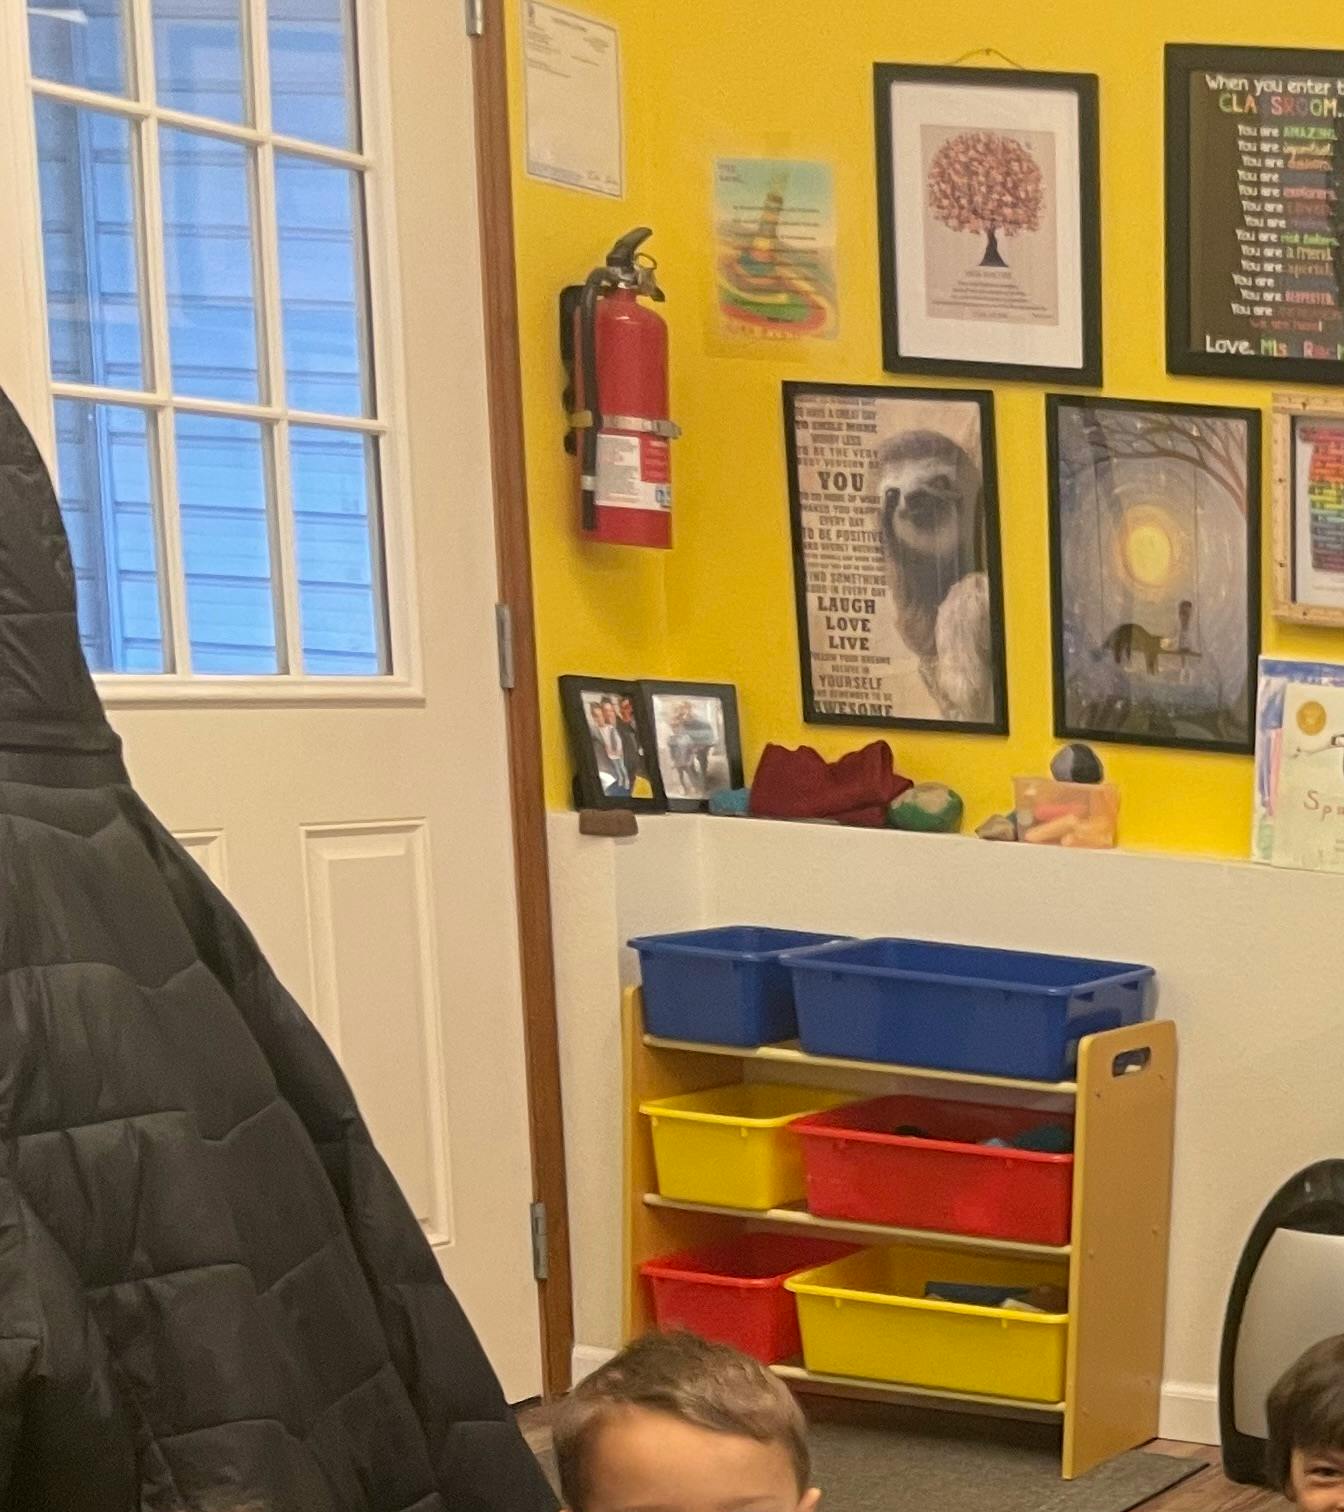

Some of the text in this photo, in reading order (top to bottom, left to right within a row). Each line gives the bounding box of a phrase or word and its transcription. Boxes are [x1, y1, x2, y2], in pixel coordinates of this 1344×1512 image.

[1205, 74, 1249, 92] When
[1254, 80, 1282, 96] you
[1287, 79, 1331, 95] enter
[1237, 125, 1257, 136] You
[1260, 126, 1279, 137] are
[1237, 140, 1257, 151] You
[1260, 142, 1280, 152] are
[1241, 155, 1261, 167] You
[1265, 157, 1284, 168] are
[1237, 170, 1279, 182] You are
[1238, 184, 1280, 197] You are
[1241, 200, 1261, 212] You
[1264, 202, 1284, 213] are
[1243, 214, 1264, 227] You
[1267, 216, 1286, 228] are
[1235, 229, 1255, 241] You
[1259, 231, 1278, 242] are
[1240, 245, 1260, 256] You
[1263, 246, 1282, 258] are
[1241, 259, 1260, 272] You
[1263, 261, 1282, 273] are
[1232, 274, 1274, 288] You are
[1240, 288, 1282, 302] You are
[1231, 303, 1272, 316] You are
[829, 447, 847, 457] THE
[852, 449, 878, 458] VERY
[817, 471, 864, 492] YOU
[819, 528, 833, 540] BE
[836, 530, 883, 543] POSITIVE
[830, 573, 886, 585] SOMETHING
[817, 596, 876, 614] LAUGH
[825, 616, 871, 632] LOVE
[829, 635, 869, 651] LIVE
[819, 675, 882, 690] YOURSELF
[815, 700, 894, 716] AWESOME
